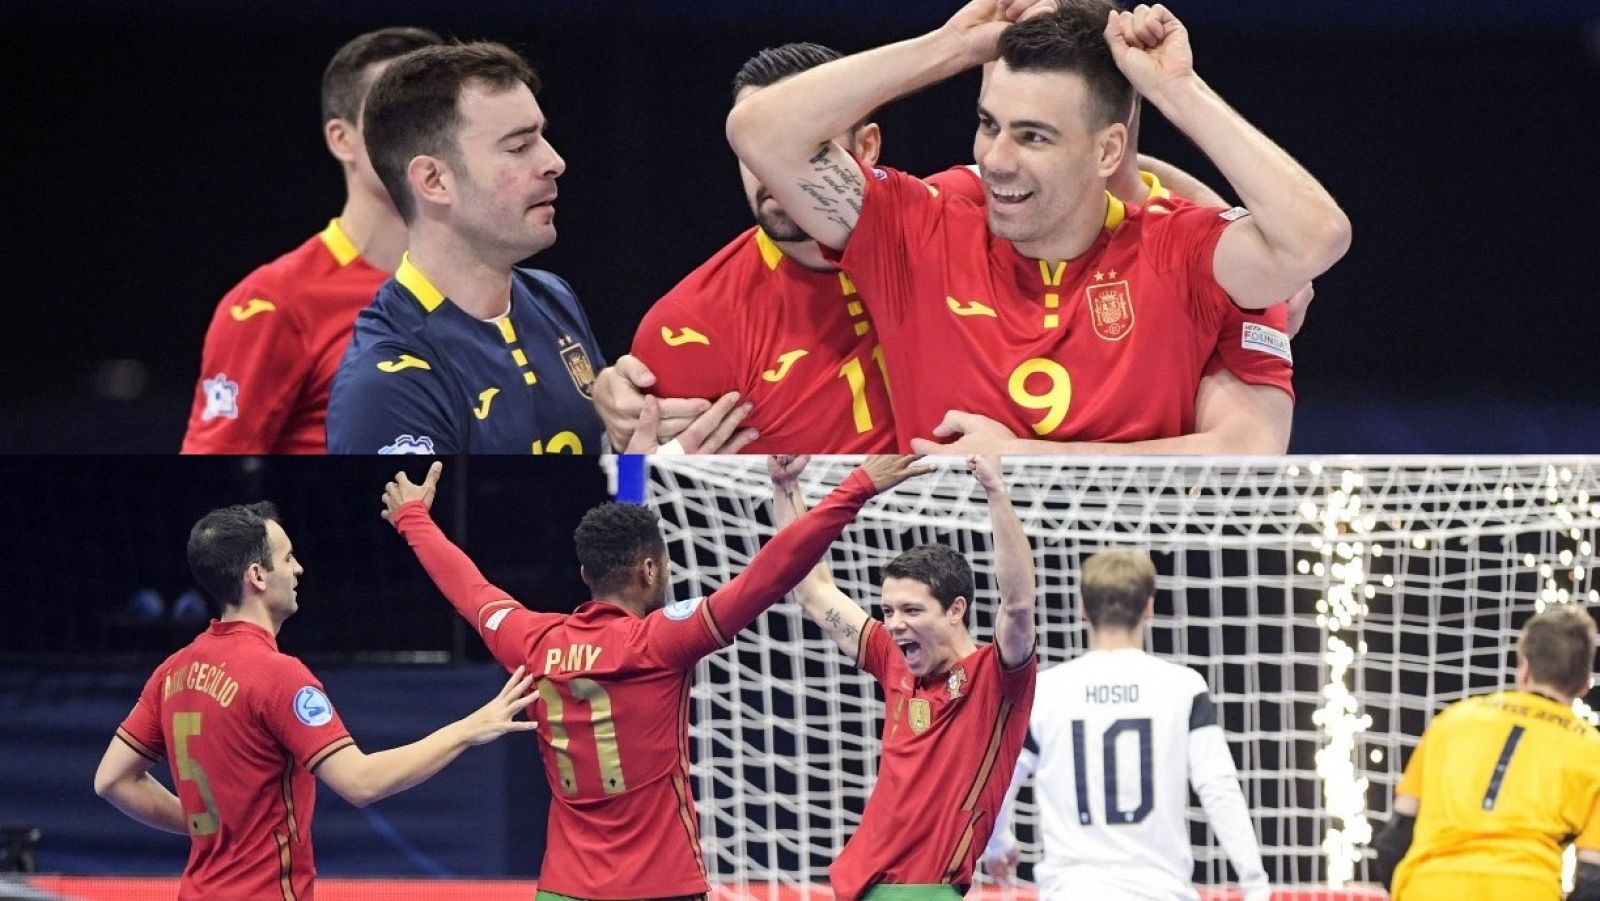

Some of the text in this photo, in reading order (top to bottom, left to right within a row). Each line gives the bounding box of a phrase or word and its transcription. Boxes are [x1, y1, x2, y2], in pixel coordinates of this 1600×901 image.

[1007, 357, 1072, 436] 9
[186, 660, 239, 708] CECÍLIO
[1085, 684, 1139, 704] HOSIO
[172, 711, 221, 836] 5
[1071, 718, 1154, 826] 10
[1482, 724, 1526, 811] 1
